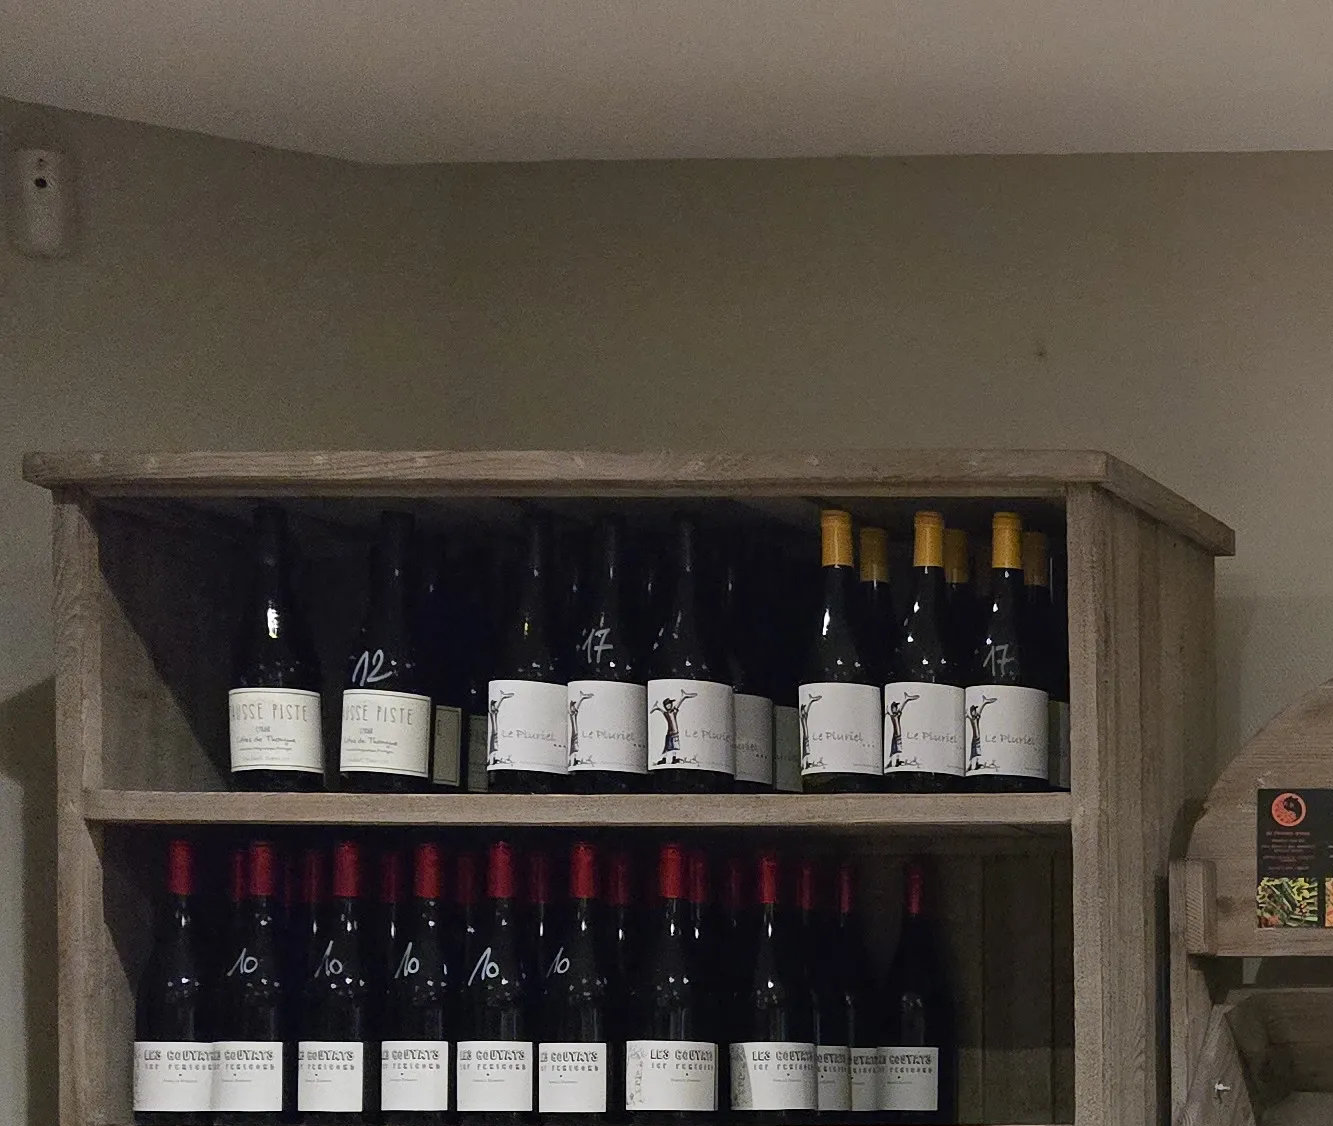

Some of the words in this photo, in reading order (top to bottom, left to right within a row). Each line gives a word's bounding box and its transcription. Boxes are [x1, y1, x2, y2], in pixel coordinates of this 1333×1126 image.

[583, 628, 613, 663] 17
[983, 644, 1014, 676] 17
[352, 649, 392, 686] 12
[273, 703, 307, 722] PISTE
[377, 706, 412, 725] PISTE
[227, 948, 258, 976] 10
[314, 940, 343, 978] 10
[395, 942, 419, 979] 10
[468, 948, 499, 986] 10
[650, 1049, 669, 1060] LES
[752, 1050, 770, 1061] LES
